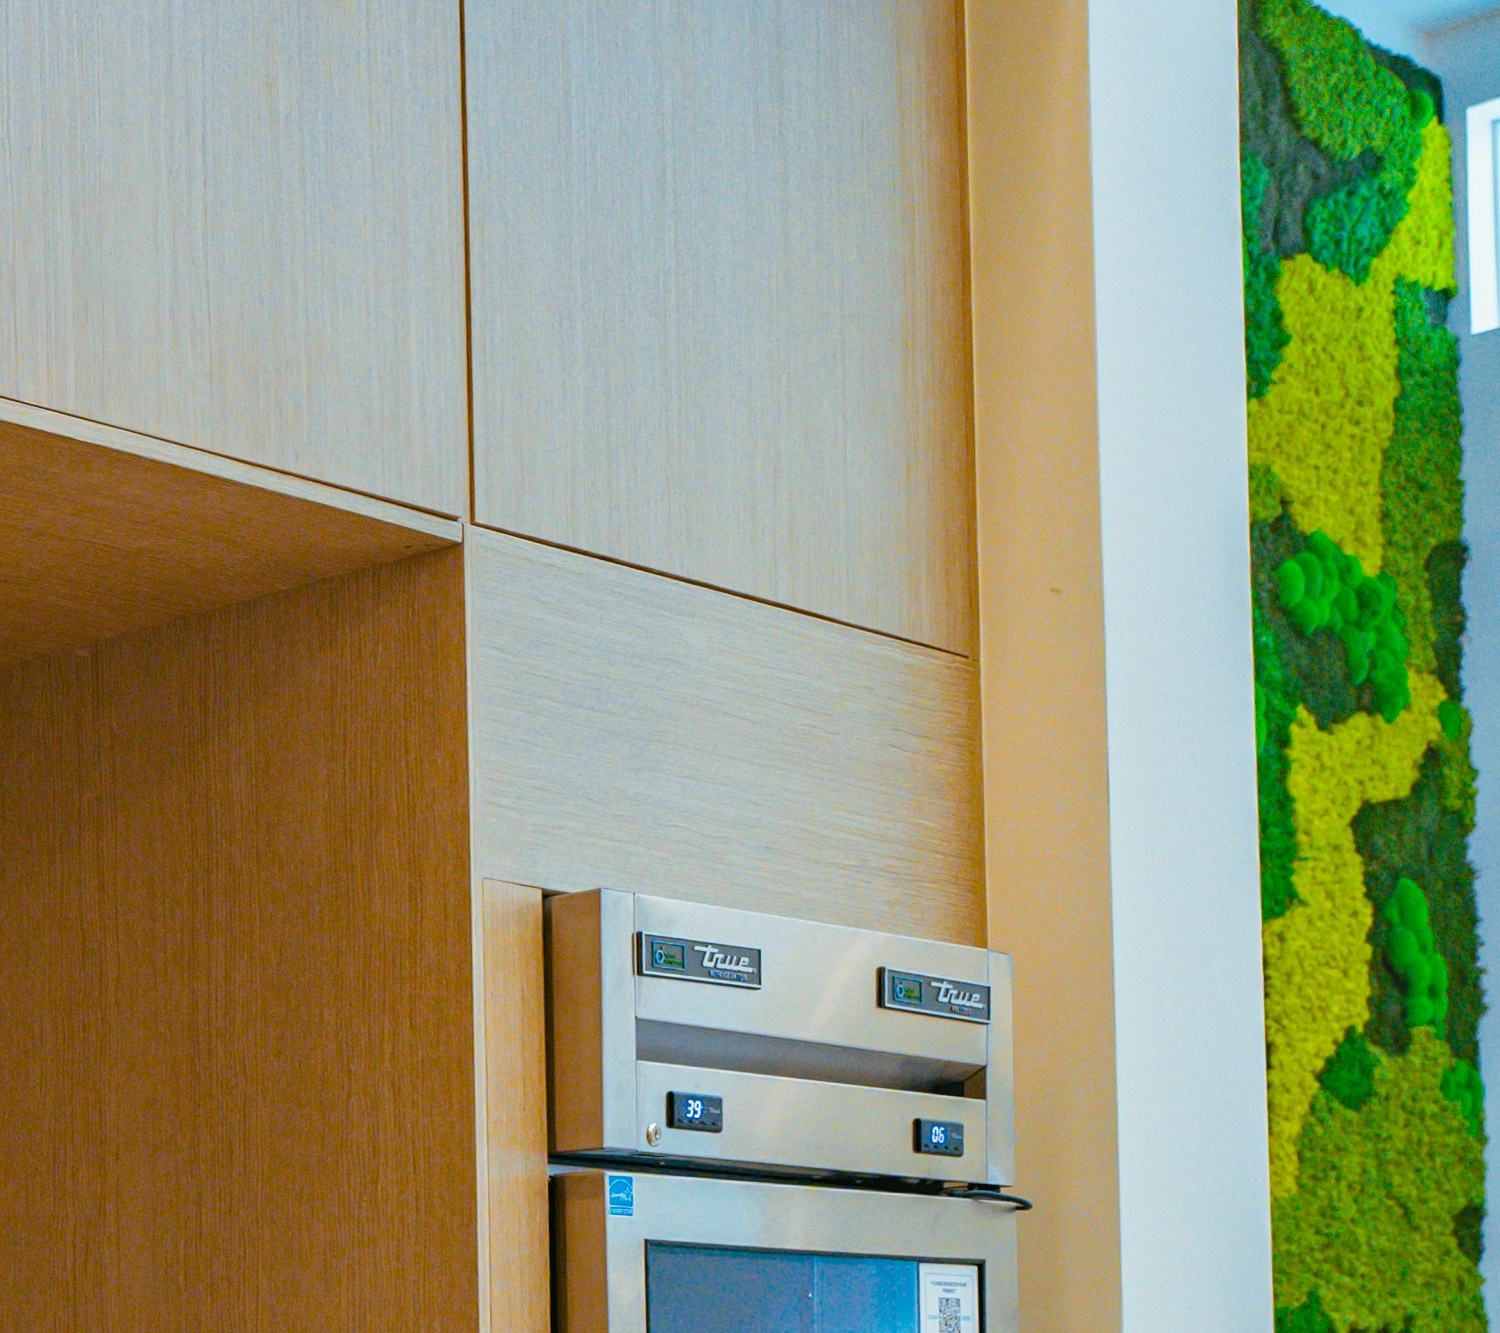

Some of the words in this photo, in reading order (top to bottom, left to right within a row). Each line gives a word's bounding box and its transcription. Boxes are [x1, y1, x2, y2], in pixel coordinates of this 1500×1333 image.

[694, 944, 752, 972] true
[930, 981, 984, 1008] true
[686, 1099, 701, 1119] 39
[931, 1125, 944, 1143] 06
